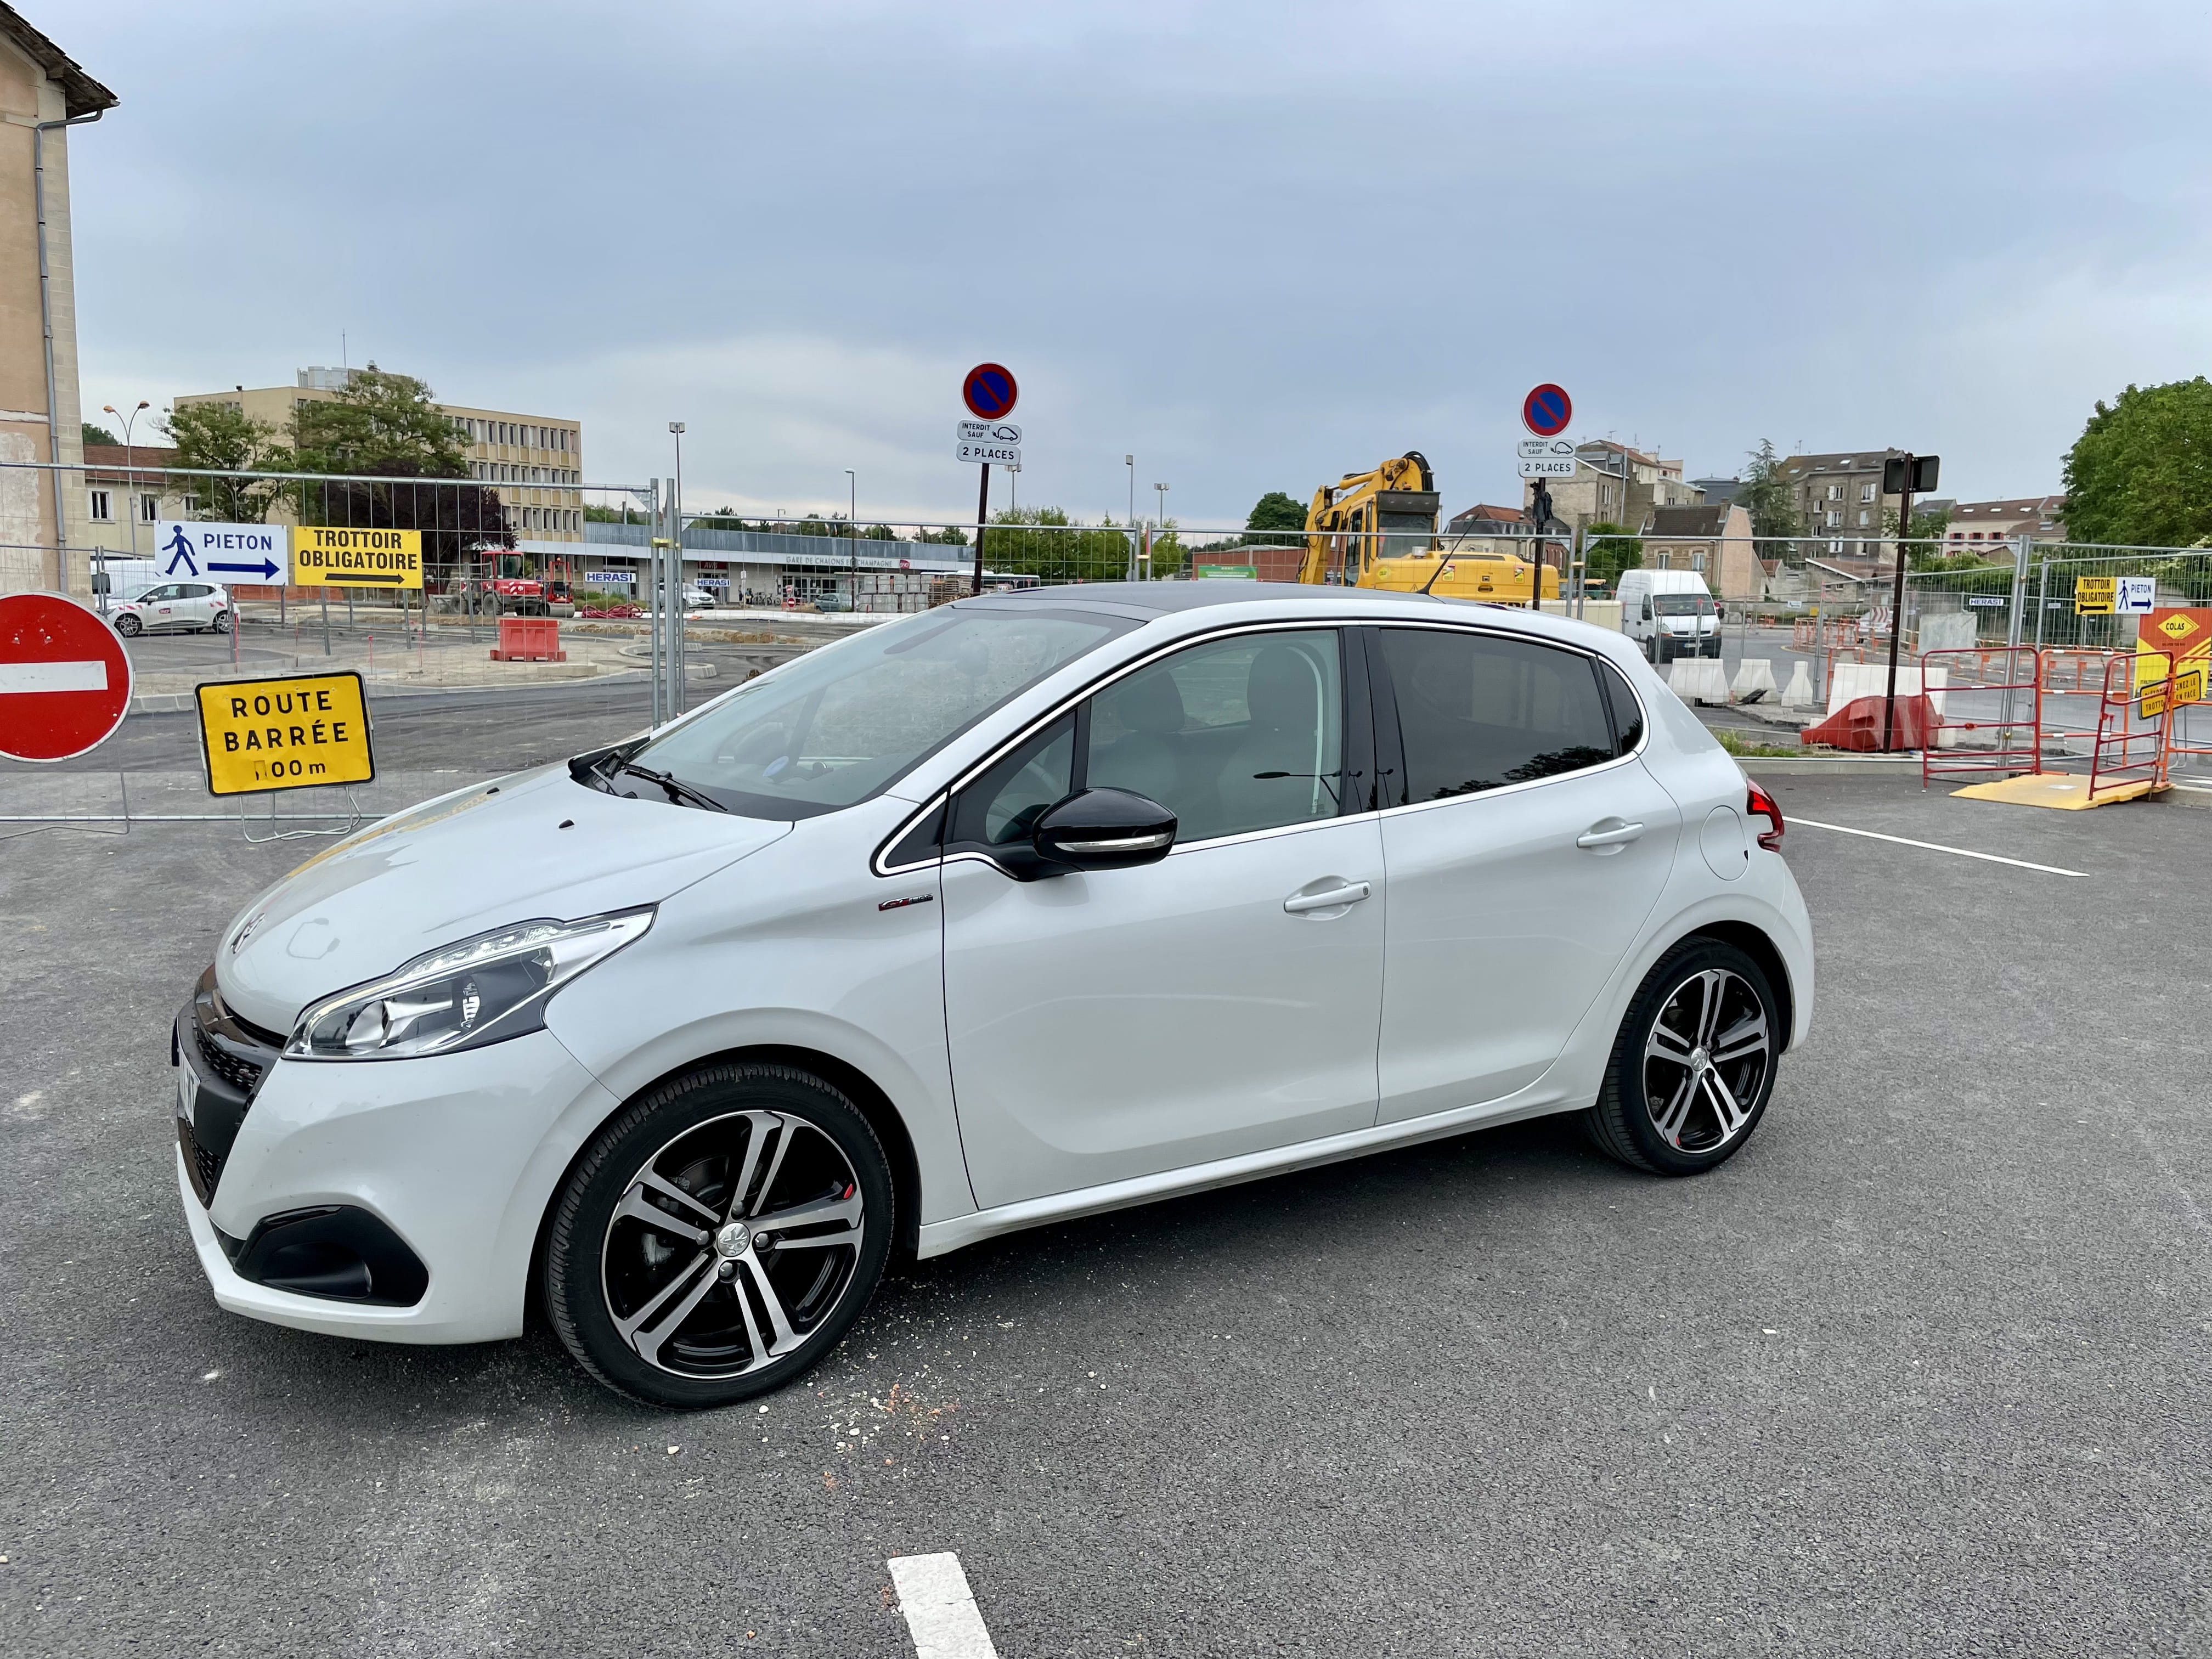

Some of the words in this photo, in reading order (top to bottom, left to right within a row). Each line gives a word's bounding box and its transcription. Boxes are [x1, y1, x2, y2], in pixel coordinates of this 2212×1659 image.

[962, 422, 990, 431] INTERDIT
[963, 447, 969, 456] 2
[974, 448, 1014, 460] PLACES
[1525, 463, 1531, 472] 2
[1536, 464, 1571, 472] PLACES
[204, 533, 272, 550] PIETON
[314, 530, 402, 549] TROTTOIR
[300, 550, 417, 570] OBLIGATOIRE
[2083, 579, 2110, 590] TROTTOIR
[2131, 584, 2151, 593] PIETON
[2078, 592, 2114, 602] OBLIGATOIRE
[2185, 689, 2196, 699] FACE
[231, 691, 332, 718] ROUTE
[2146, 699, 2164, 712] TROTTO
[224, 719, 348, 752] BARRÉE
